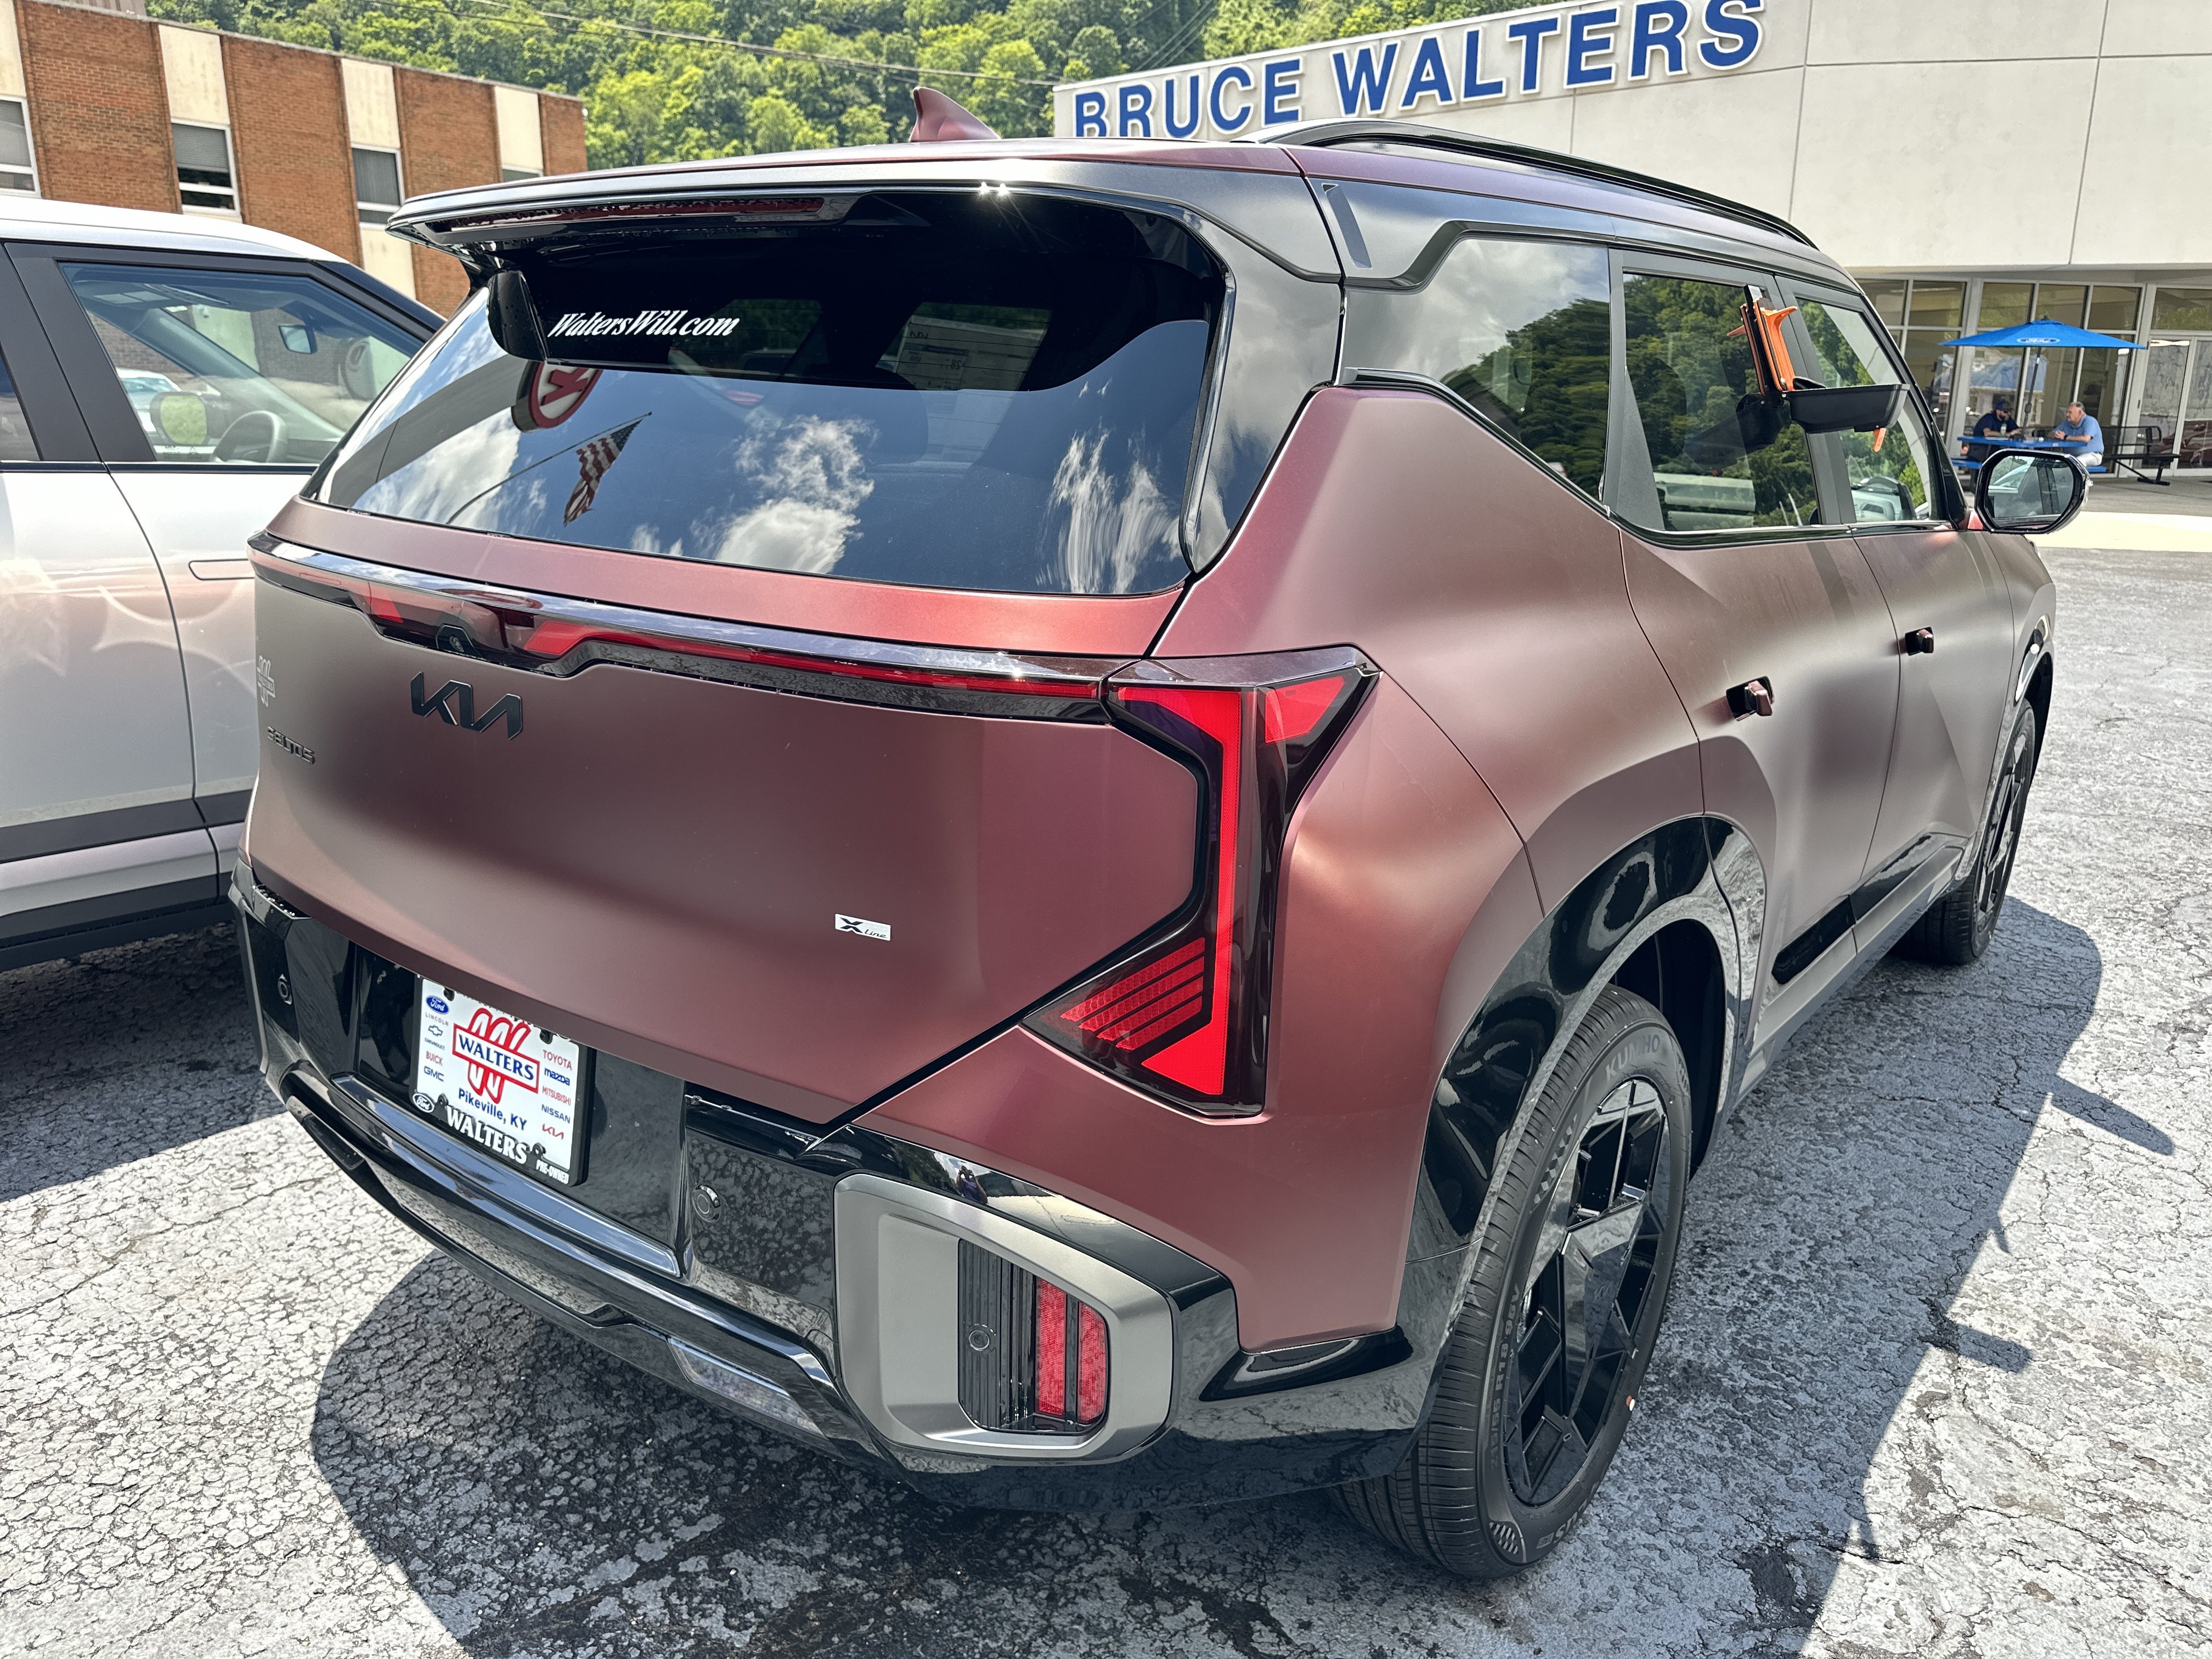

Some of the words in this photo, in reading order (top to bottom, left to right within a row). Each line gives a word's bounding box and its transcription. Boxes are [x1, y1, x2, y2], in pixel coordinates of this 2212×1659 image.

[1074, 57, 1302, 139] BRUCE
[1330, 0, 1763, 116] WALTERS
[548, 310, 740, 337] WaltersWill.com
[410, 672, 522, 740] KIA
[430, 997, 445, 1012] Ford
[425, 1012, 449, 1026] LINCOLN
[425, 1037, 445, 1050] CHEVROLET
[426, 1051, 443, 1066] BUICK
[459, 1034, 534, 1081] WALTERS
[543, 1049, 572, 1070] TOYOTA
[424, 1065, 444, 1082] GMC
[542, 1086, 572, 1106] MITSUBISHI
[459, 1088, 507, 1124] Pikeville,
[510, 1114, 527, 1131] KY
[541, 1104, 571, 1124] NISSAN
[446, 1104, 528, 1164] WALTERS
[542, 1124, 565, 1140] KIA
[536, 1160, 569, 1184] PRE-OWNED
